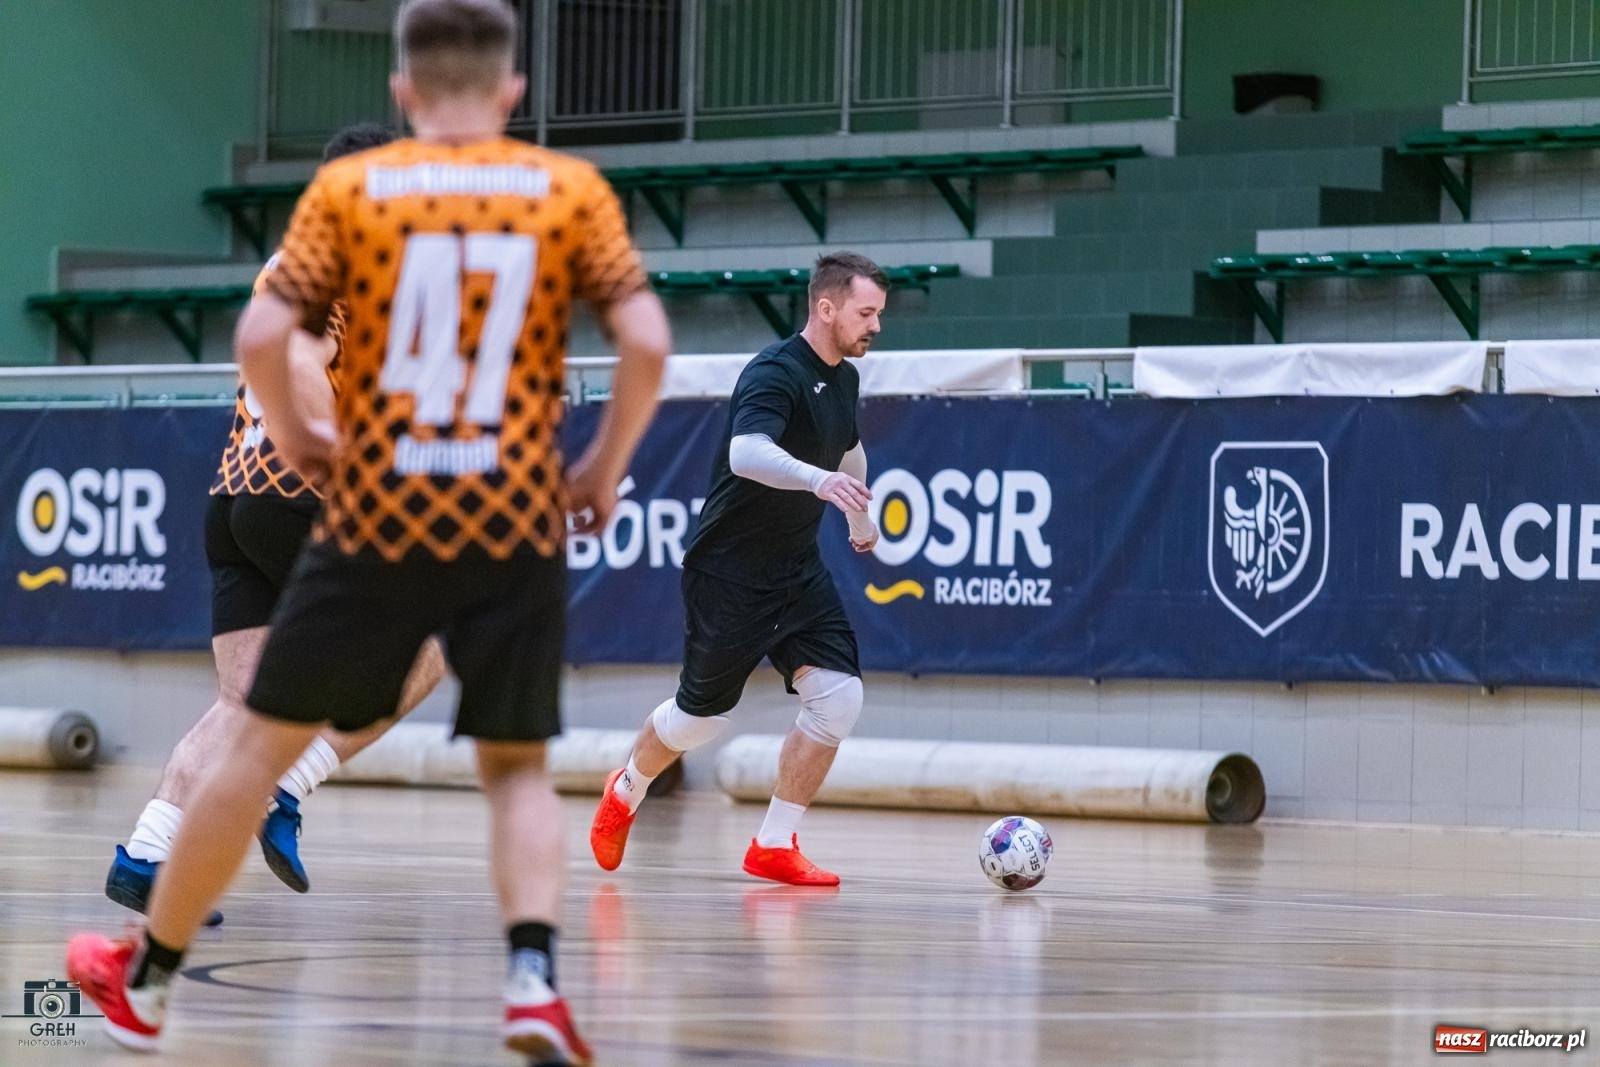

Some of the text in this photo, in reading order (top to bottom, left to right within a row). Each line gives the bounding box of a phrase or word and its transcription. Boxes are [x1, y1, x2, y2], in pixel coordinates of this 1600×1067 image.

[380, 234, 537, 425] 47
[16, 467, 167, 557] OSiR
[867, 468, 1052, 568] OSiR
[71, 557, 166, 591] RACIBÓRZ
[934, 570, 1053, 606] RACIBÓRZ
[1018, 834, 1041, 872] SELECT
